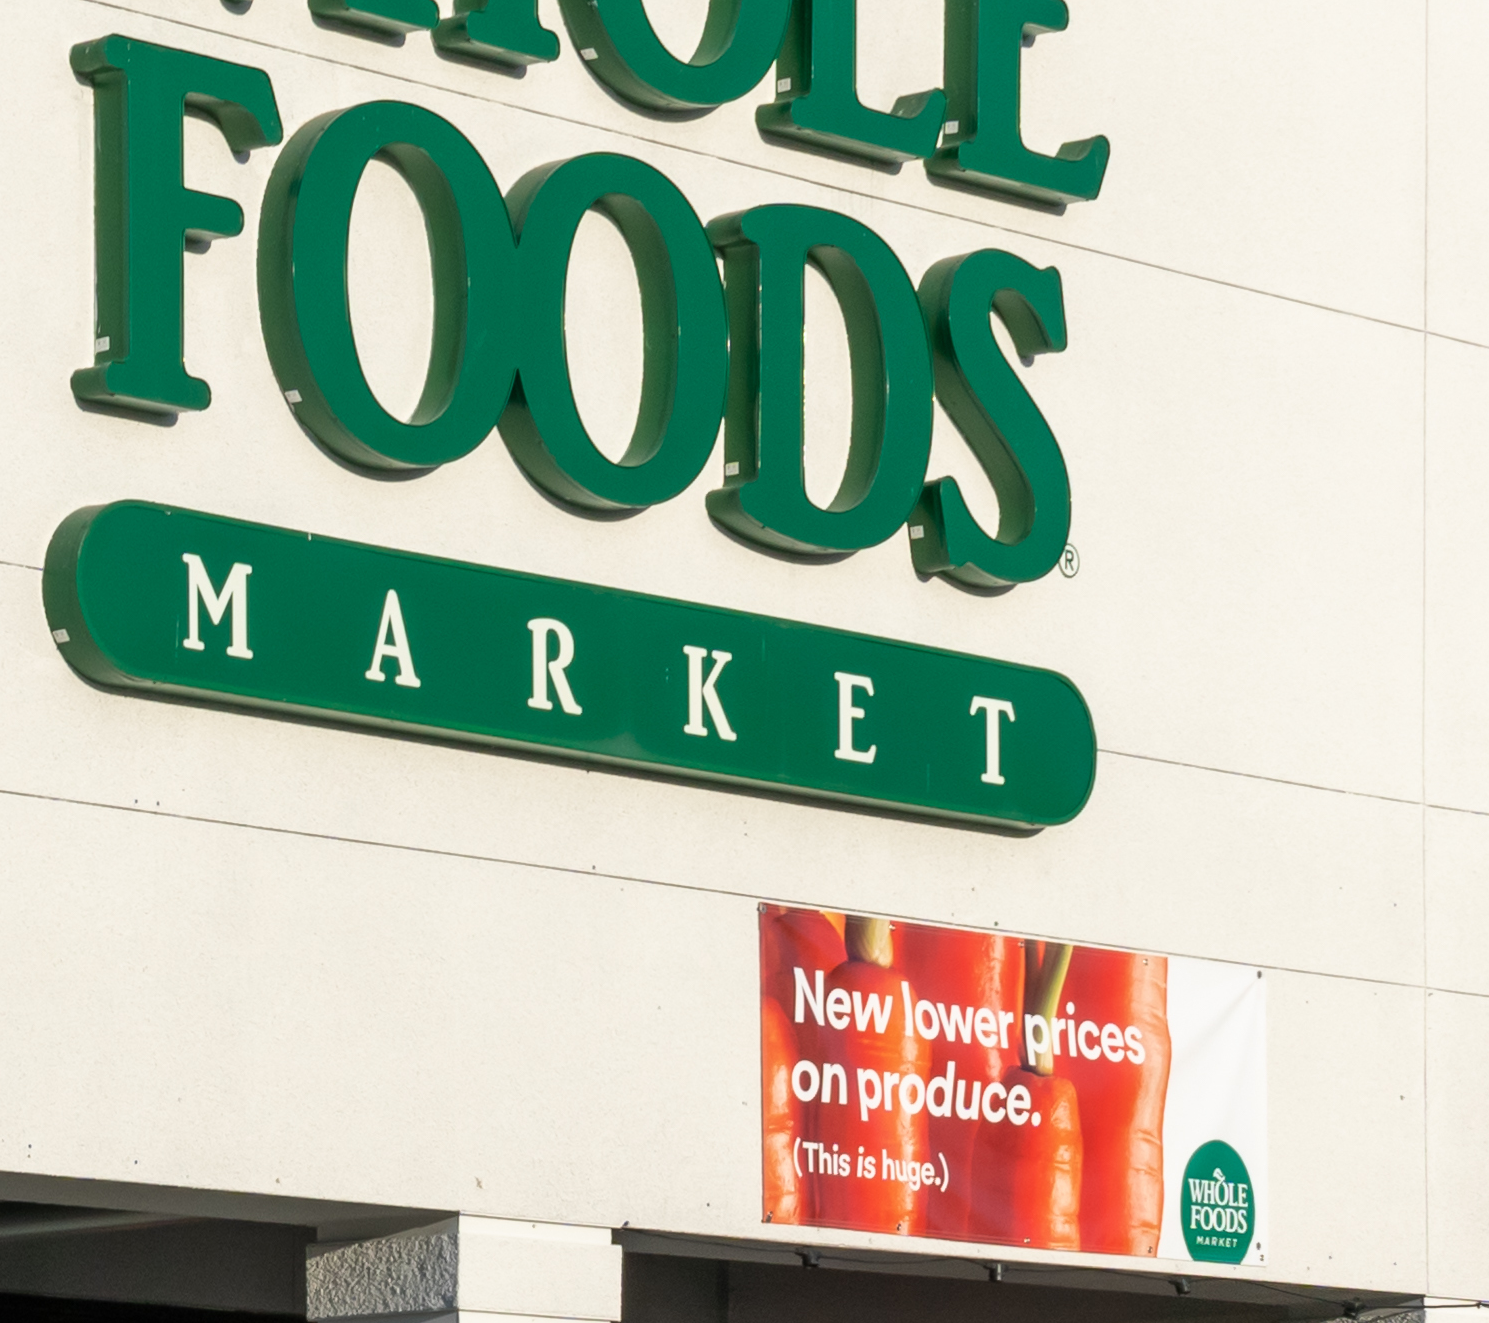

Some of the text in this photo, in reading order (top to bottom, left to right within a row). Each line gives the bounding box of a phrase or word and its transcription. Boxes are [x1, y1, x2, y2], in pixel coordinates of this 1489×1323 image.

[69, 32, 1073, 589] FOODS
[181, 552, 1017, 786] MARKET
[792, 967, 1146, 1066] New lower prices
[791, 1059, 1042, 1128] on produce.
[792, 1137, 950, 1192] (This is huge.)
[1187, 1167, 1249, 1208] WHOLE
[1190, 1204, 1248, 1234] FOODS
[1195, 1235, 1238, 1248] MARKET
